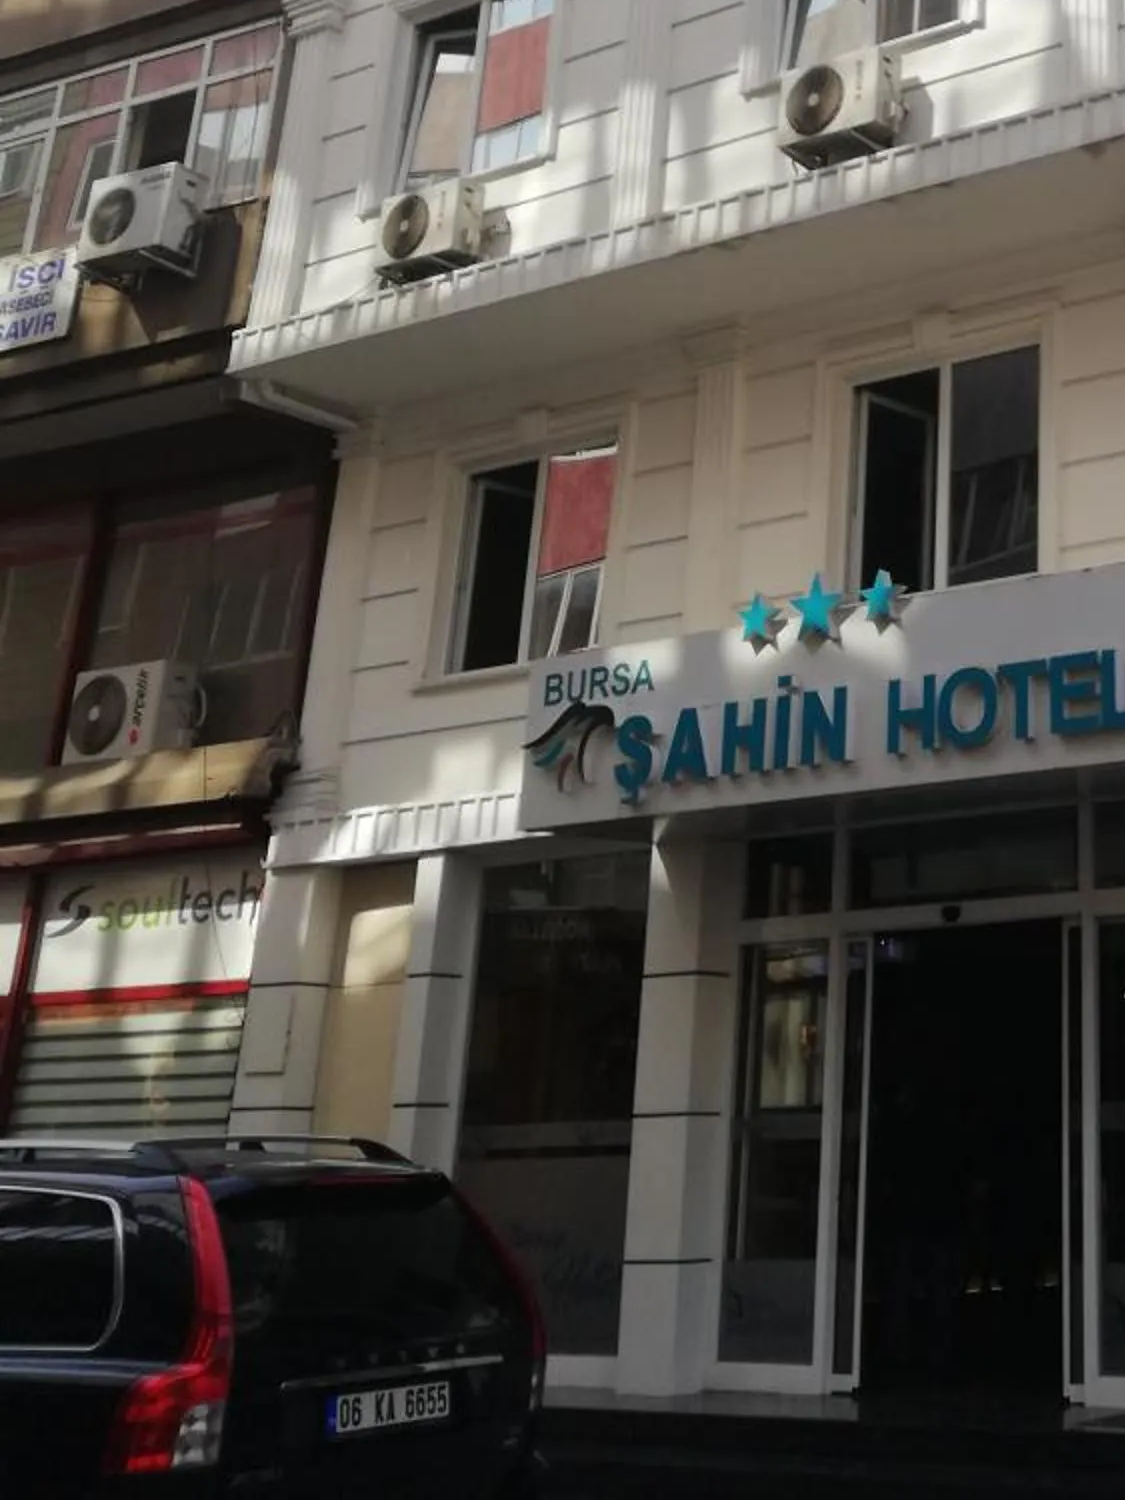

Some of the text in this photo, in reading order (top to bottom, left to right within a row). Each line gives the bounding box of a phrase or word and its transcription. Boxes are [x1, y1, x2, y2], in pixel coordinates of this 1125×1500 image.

[544, 659, 654, 706] BURSA
[98, 870, 258, 933] soultech
[339, 1397, 362, 1430] 06
[374, 1391, 396, 1426] KA
[404, 1384, 448, 1419] 6655
